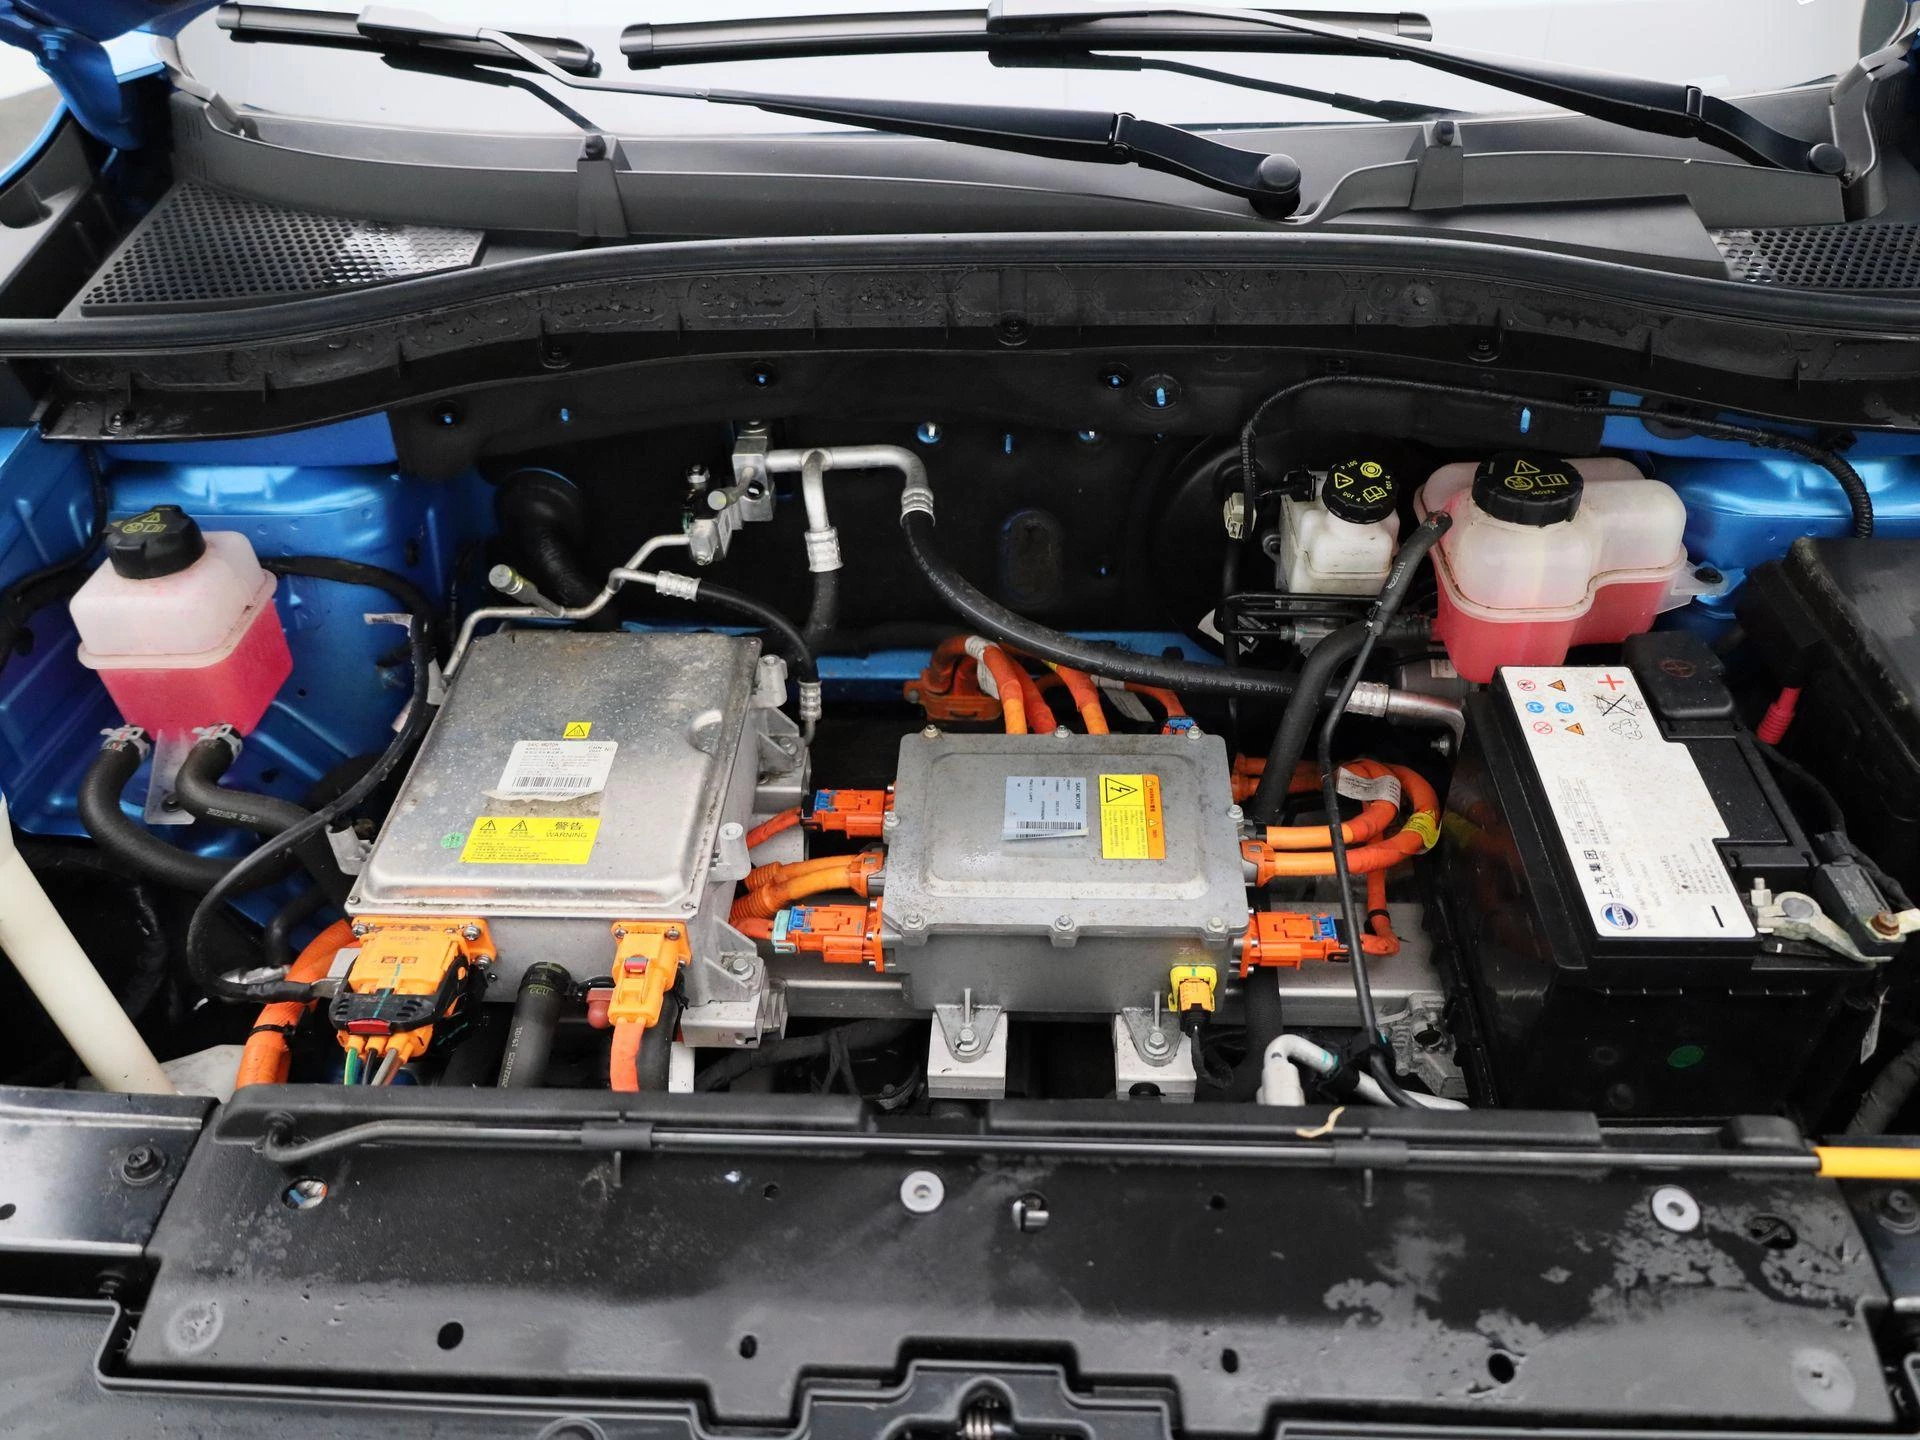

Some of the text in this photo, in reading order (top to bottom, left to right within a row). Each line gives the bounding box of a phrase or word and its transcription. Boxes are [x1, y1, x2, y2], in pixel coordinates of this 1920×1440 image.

[1235, 680, 1252, 690] SLE
[1255, 682, 1294, 695] GALAXY
[1583, 849, 1614, 898] 上汽集团
[1612, 905, 1627, 927] SAIC
